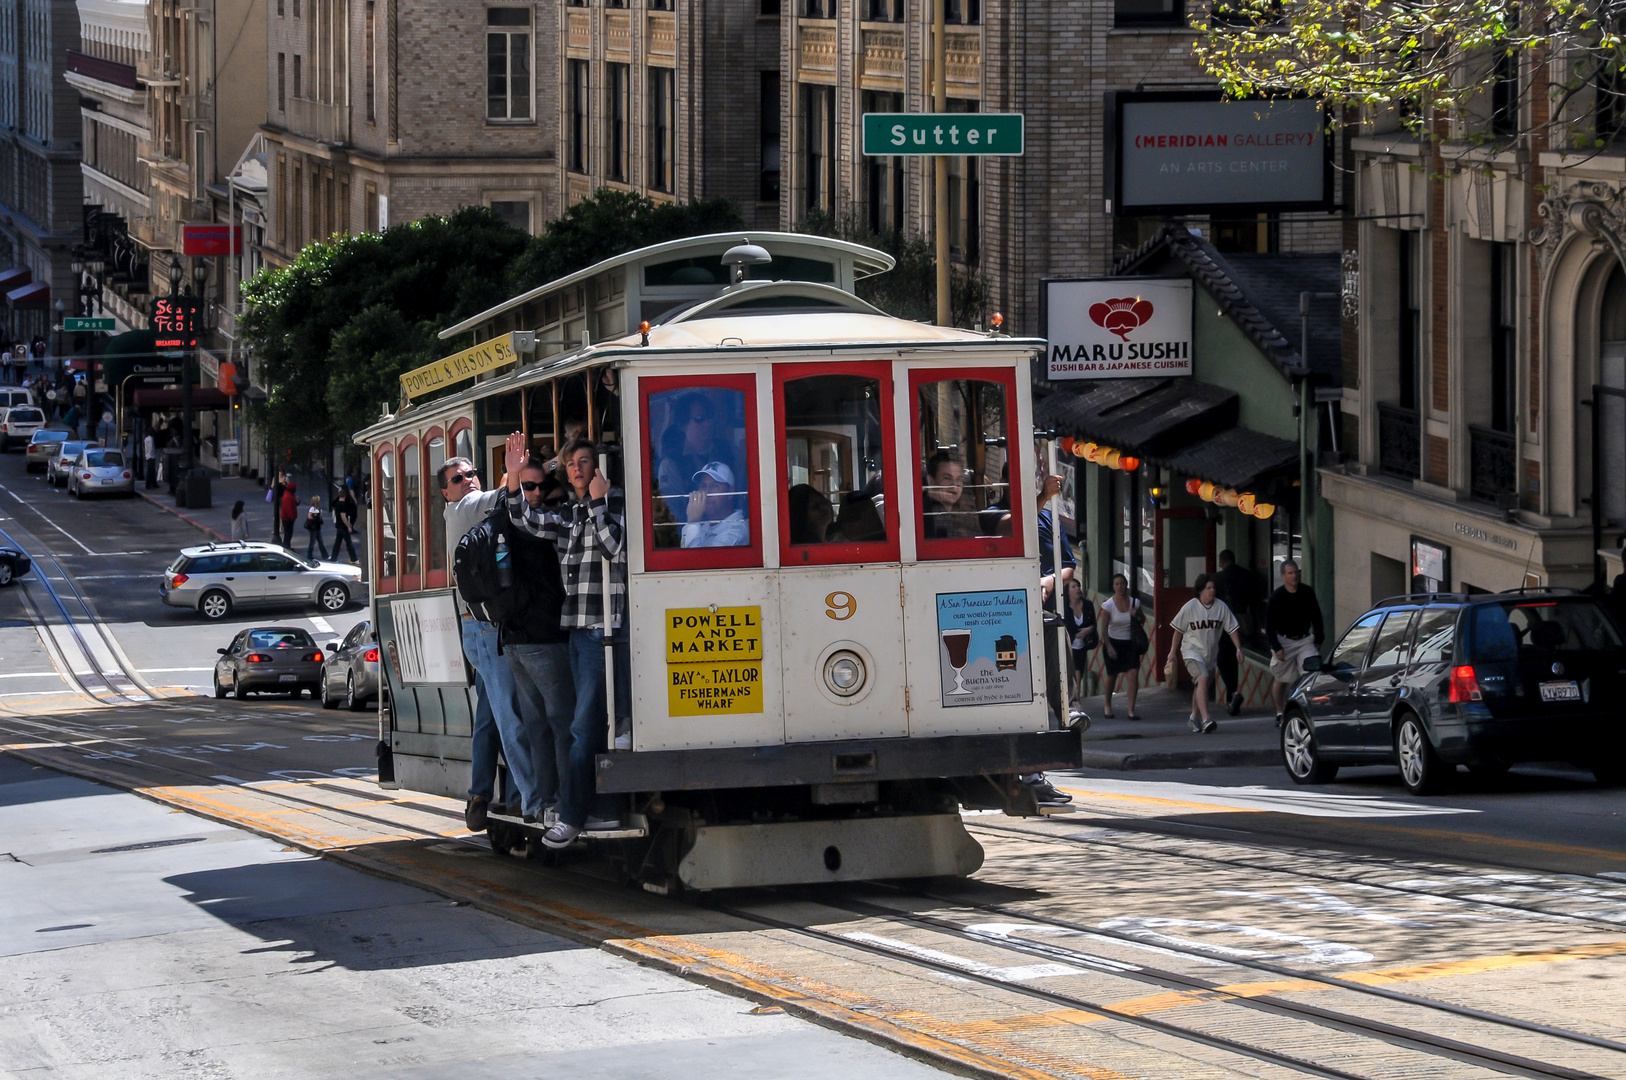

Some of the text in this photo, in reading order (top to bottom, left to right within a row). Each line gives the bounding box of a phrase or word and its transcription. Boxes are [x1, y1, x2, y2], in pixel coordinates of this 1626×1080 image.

[890, 124, 997, 146] Sutter
[1135, 134, 1229, 149] (MERIDIAN
[1160, 160, 1288, 173] AN ARTS CENTER
[77, 320, 103, 328] Post
[1051, 341, 1188, 362] MARU SUSHI
[405, 367, 444, 392] POWELL
[443, 363, 454, 379] &
[453, 347, 493, 376] MASON
[1050, 360, 1189, 372] SUSHI BAR & JAPANESE CUISINE
[824, 591, 857, 621] 9
[948, 599, 961, 609] San
[961, 597, 992, 608] Francisco
[993, 594, 1025, 606] Tradition
[672, 613, 756, 629] POWELL
[695, 628, 736, 639] AND
[671, 638, 758, 653] MARKET
[672, 670, 695, 686] BAY
[711, 667, 759, 684] TAYLOR
[980, 669, 994, 677] the
[680, 686, 751, 699] FISHERMANS
[697, 698, 734, 709] WHARF
